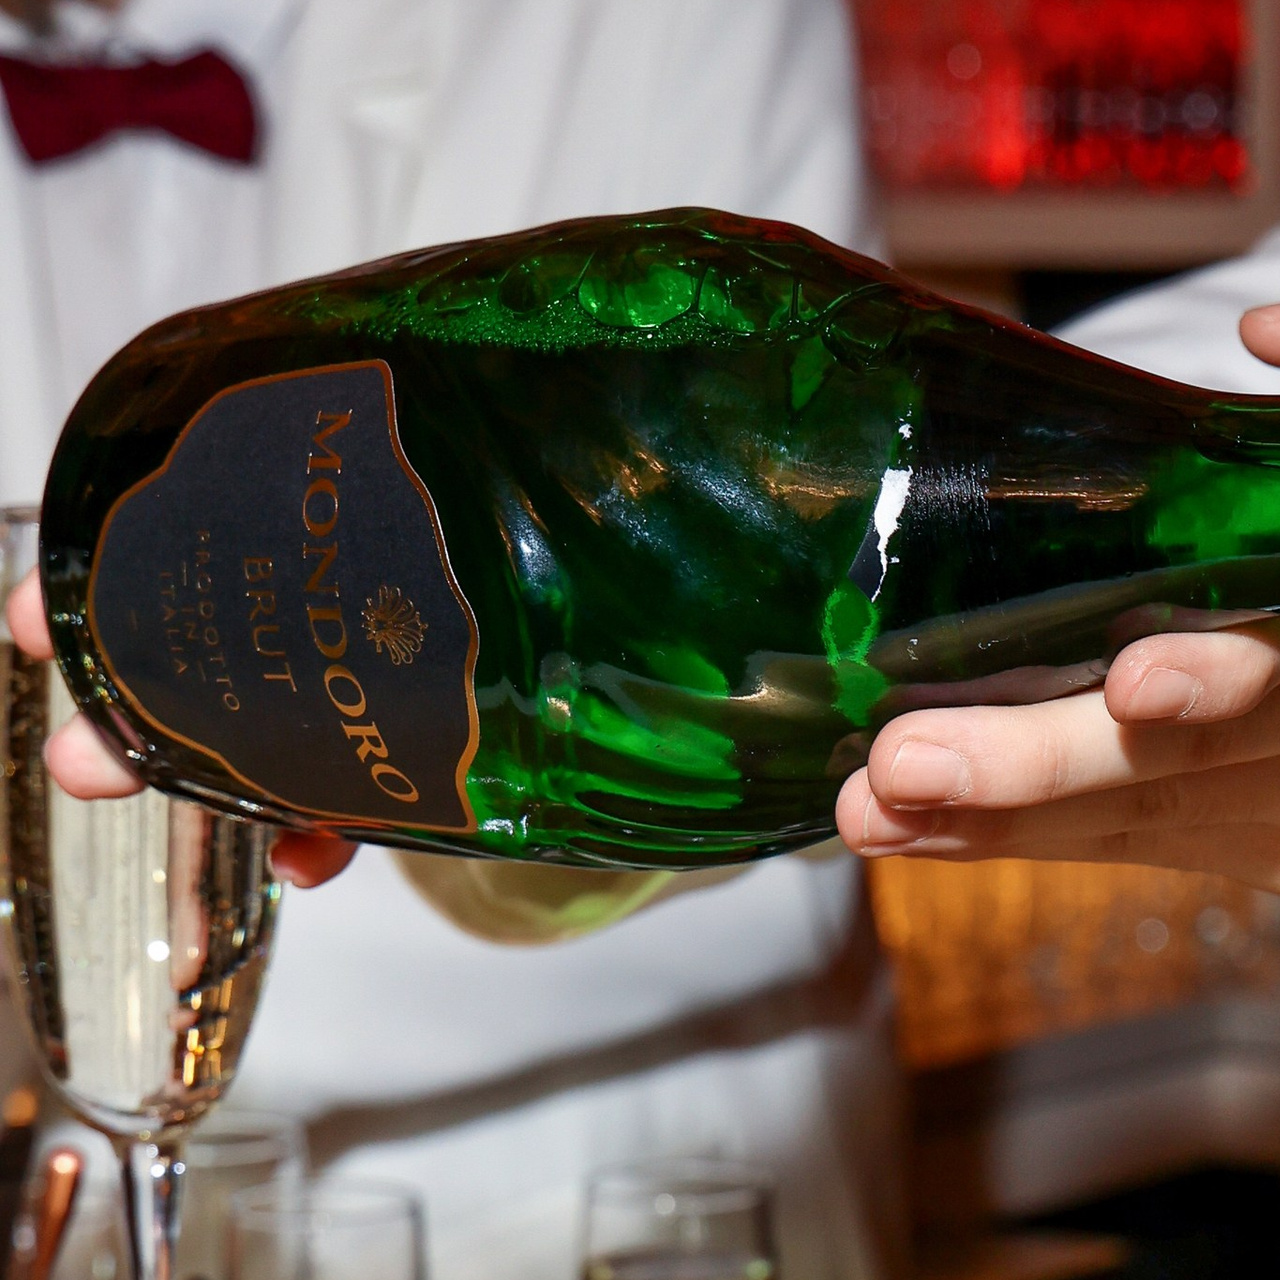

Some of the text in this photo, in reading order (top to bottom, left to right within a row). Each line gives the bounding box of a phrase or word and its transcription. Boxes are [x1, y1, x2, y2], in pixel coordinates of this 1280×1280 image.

[159, 571, 188, 677] ITALIA
[181, 604, 199, 641] IN
[196, 529, 241, 711] PRODOTTO
[243, 556, 298, 694] BRUT
[302, 408, 420, 804] MONDORO
